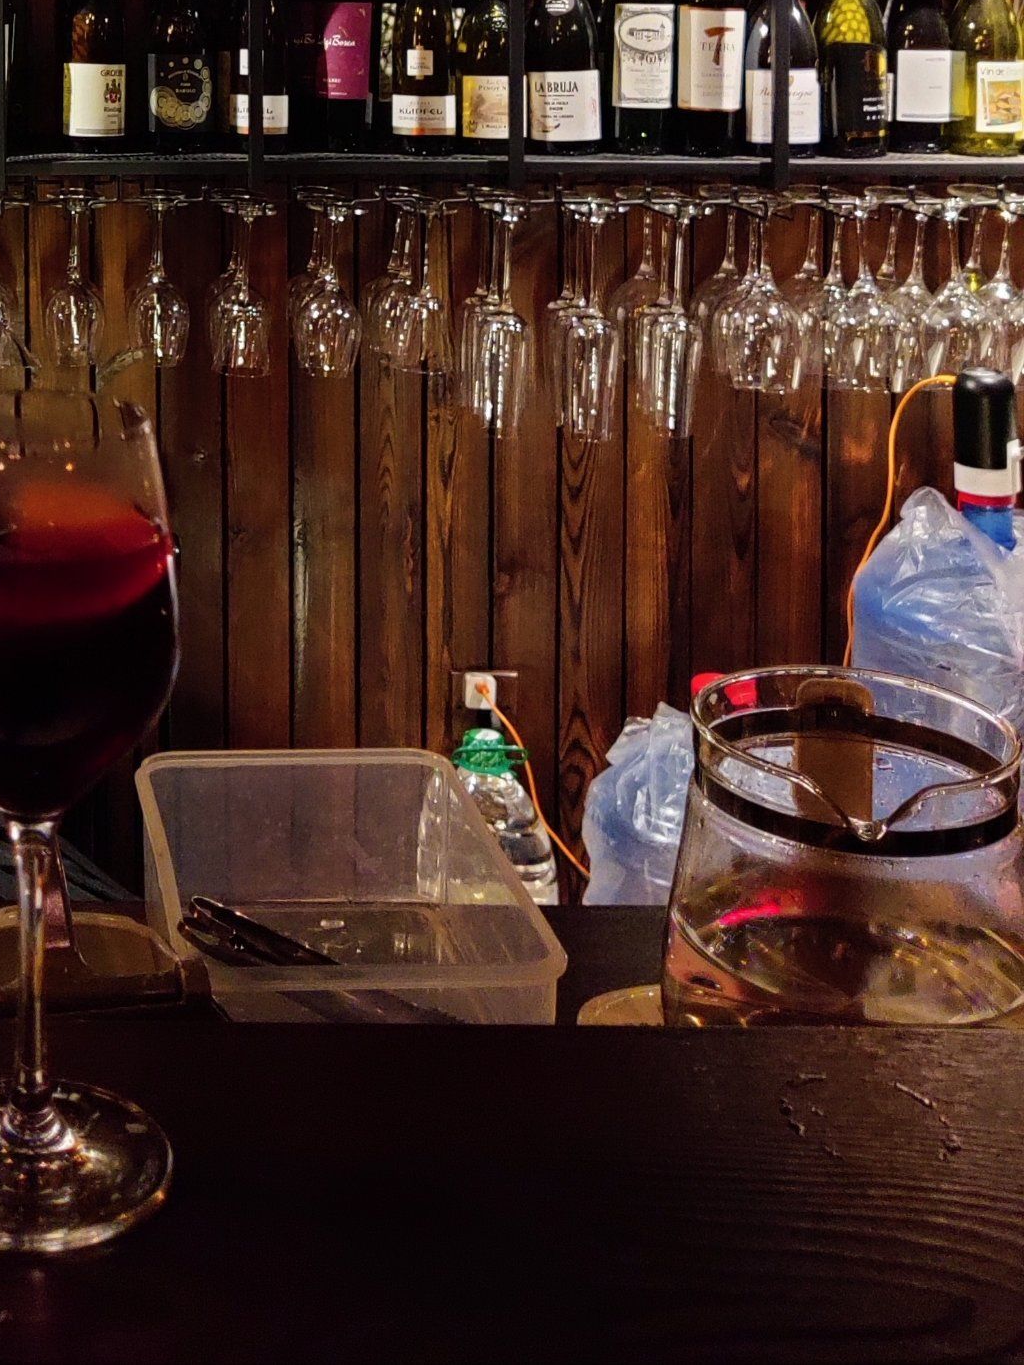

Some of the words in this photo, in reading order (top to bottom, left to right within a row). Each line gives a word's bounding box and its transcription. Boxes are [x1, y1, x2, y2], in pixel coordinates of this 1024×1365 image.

[701, 42, 736, 52] TERA
[534, 80, 546, 94] LA
[546, 80, 580, 94] BRUJA
[399, 107, 444, 116] KLIPFEL
